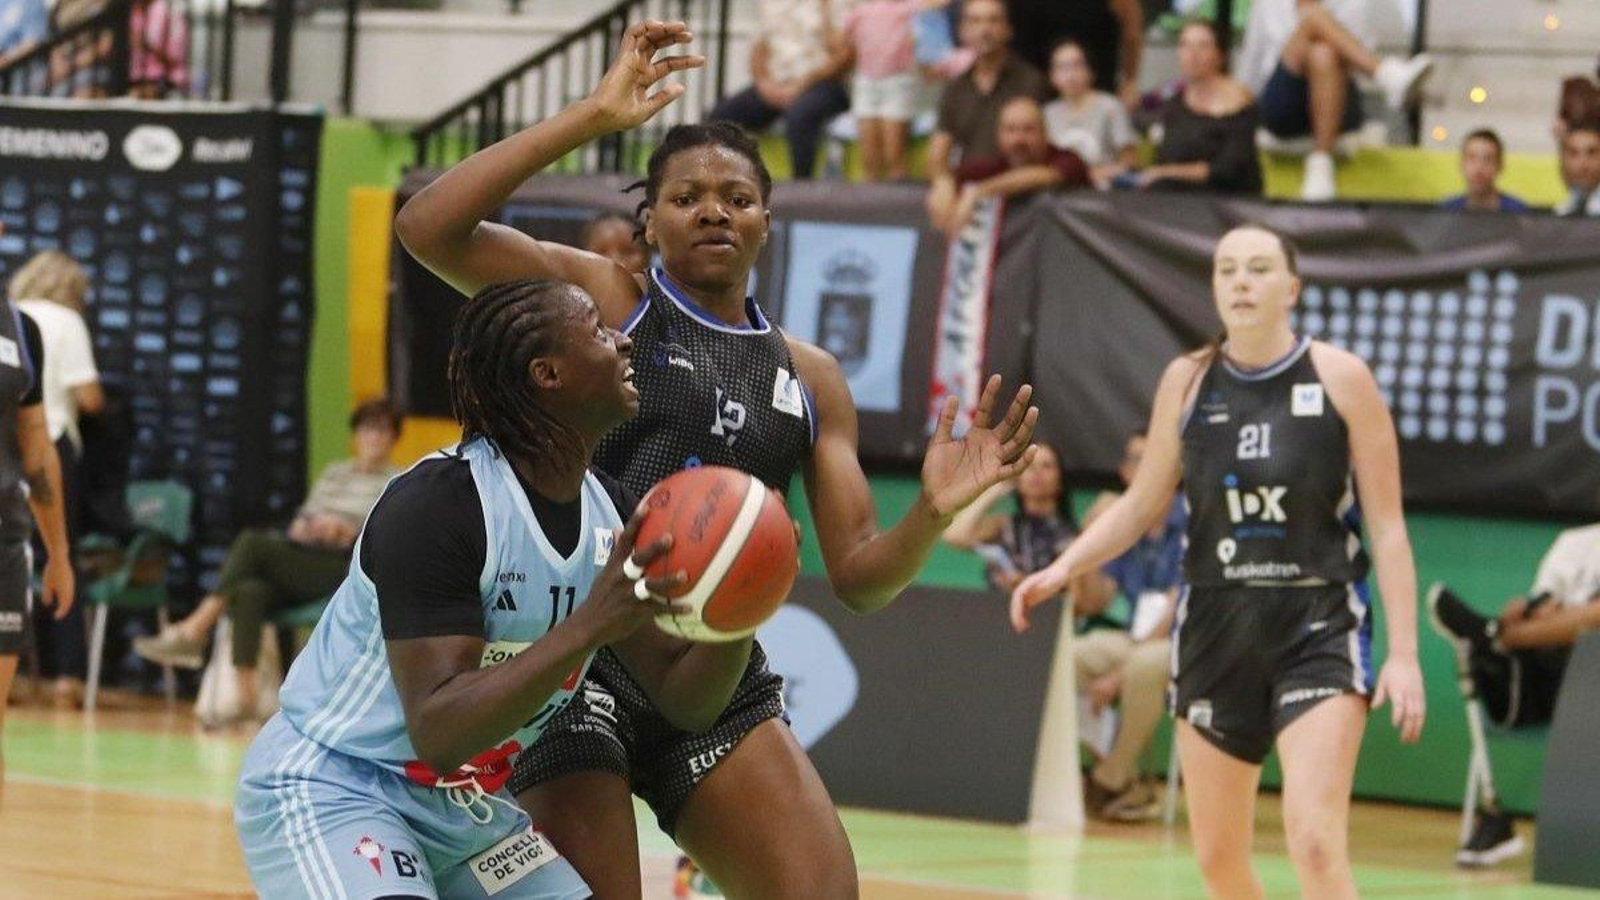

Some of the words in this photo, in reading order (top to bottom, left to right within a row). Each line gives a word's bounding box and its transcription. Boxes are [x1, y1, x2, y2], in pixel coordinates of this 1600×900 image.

[1236, 423, 1271, 460] 21
[546, 585, 576, 634] 11
[493, 862, 515, 881] DE
